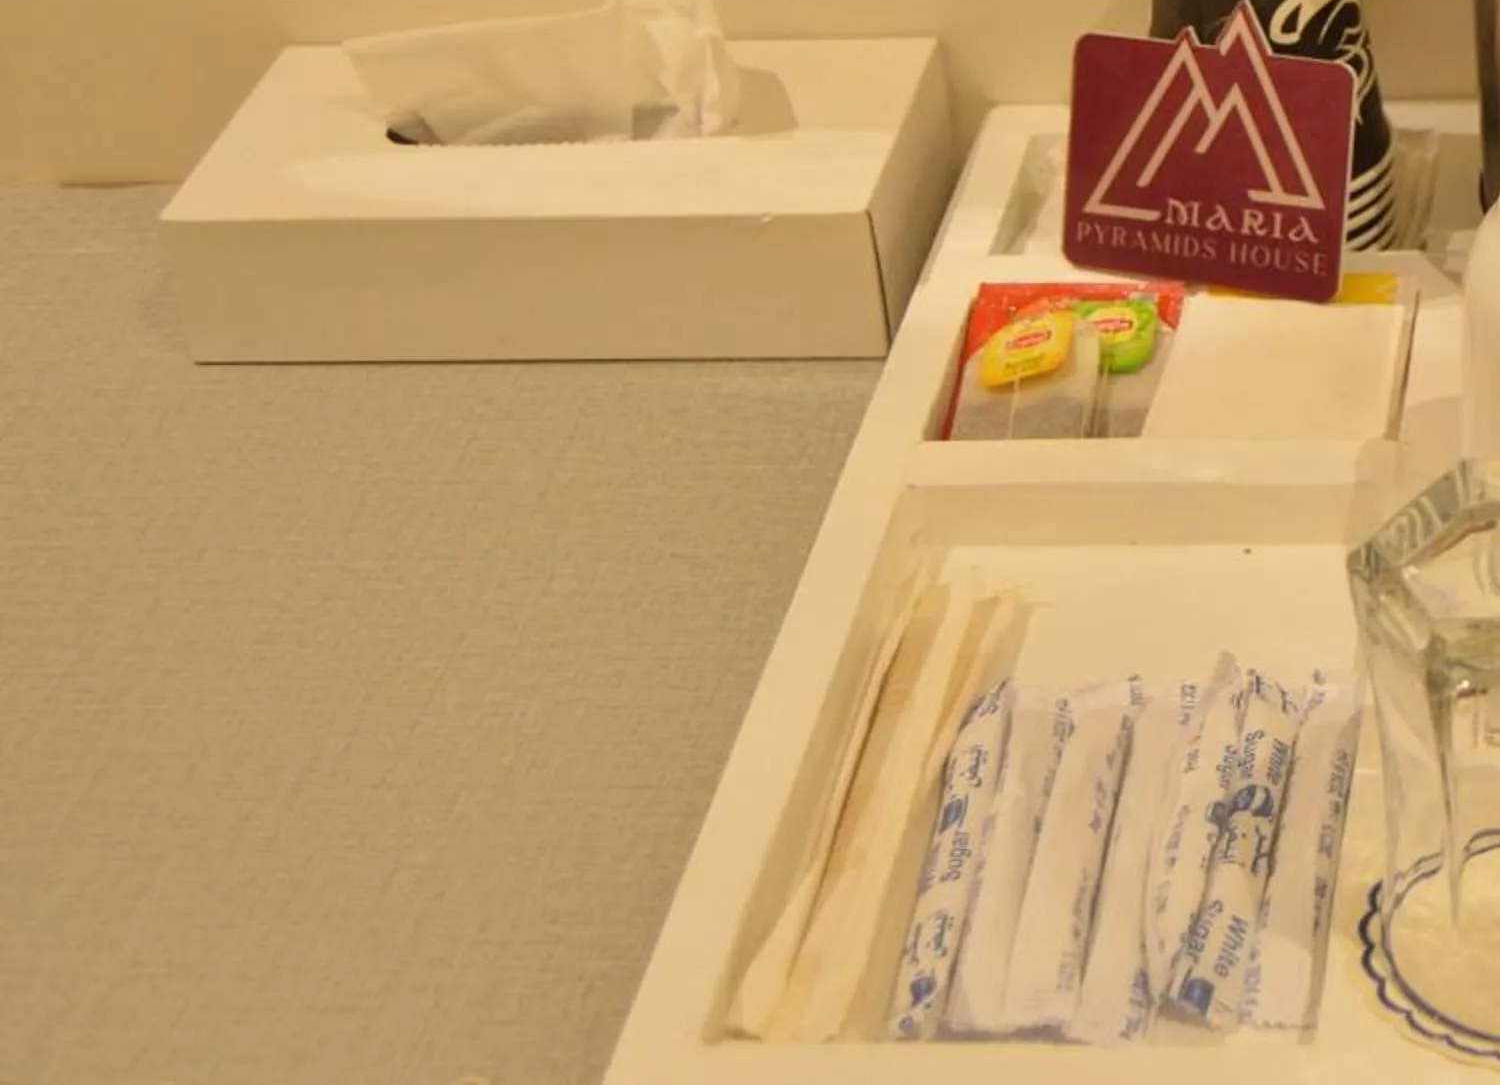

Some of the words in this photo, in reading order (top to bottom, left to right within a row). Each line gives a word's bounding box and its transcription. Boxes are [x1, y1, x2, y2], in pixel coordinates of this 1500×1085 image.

[1076, 220, 1217, 260] PYRAMIDS
[1229, 241, 1327, 276] HOUSE
[1163, 198, 1319, 244] MARIA
[938, 830, 972, 882] Sugar
[1183, 899, 1224, 965] Sugar
[1213, 915, 1249, 979] White
